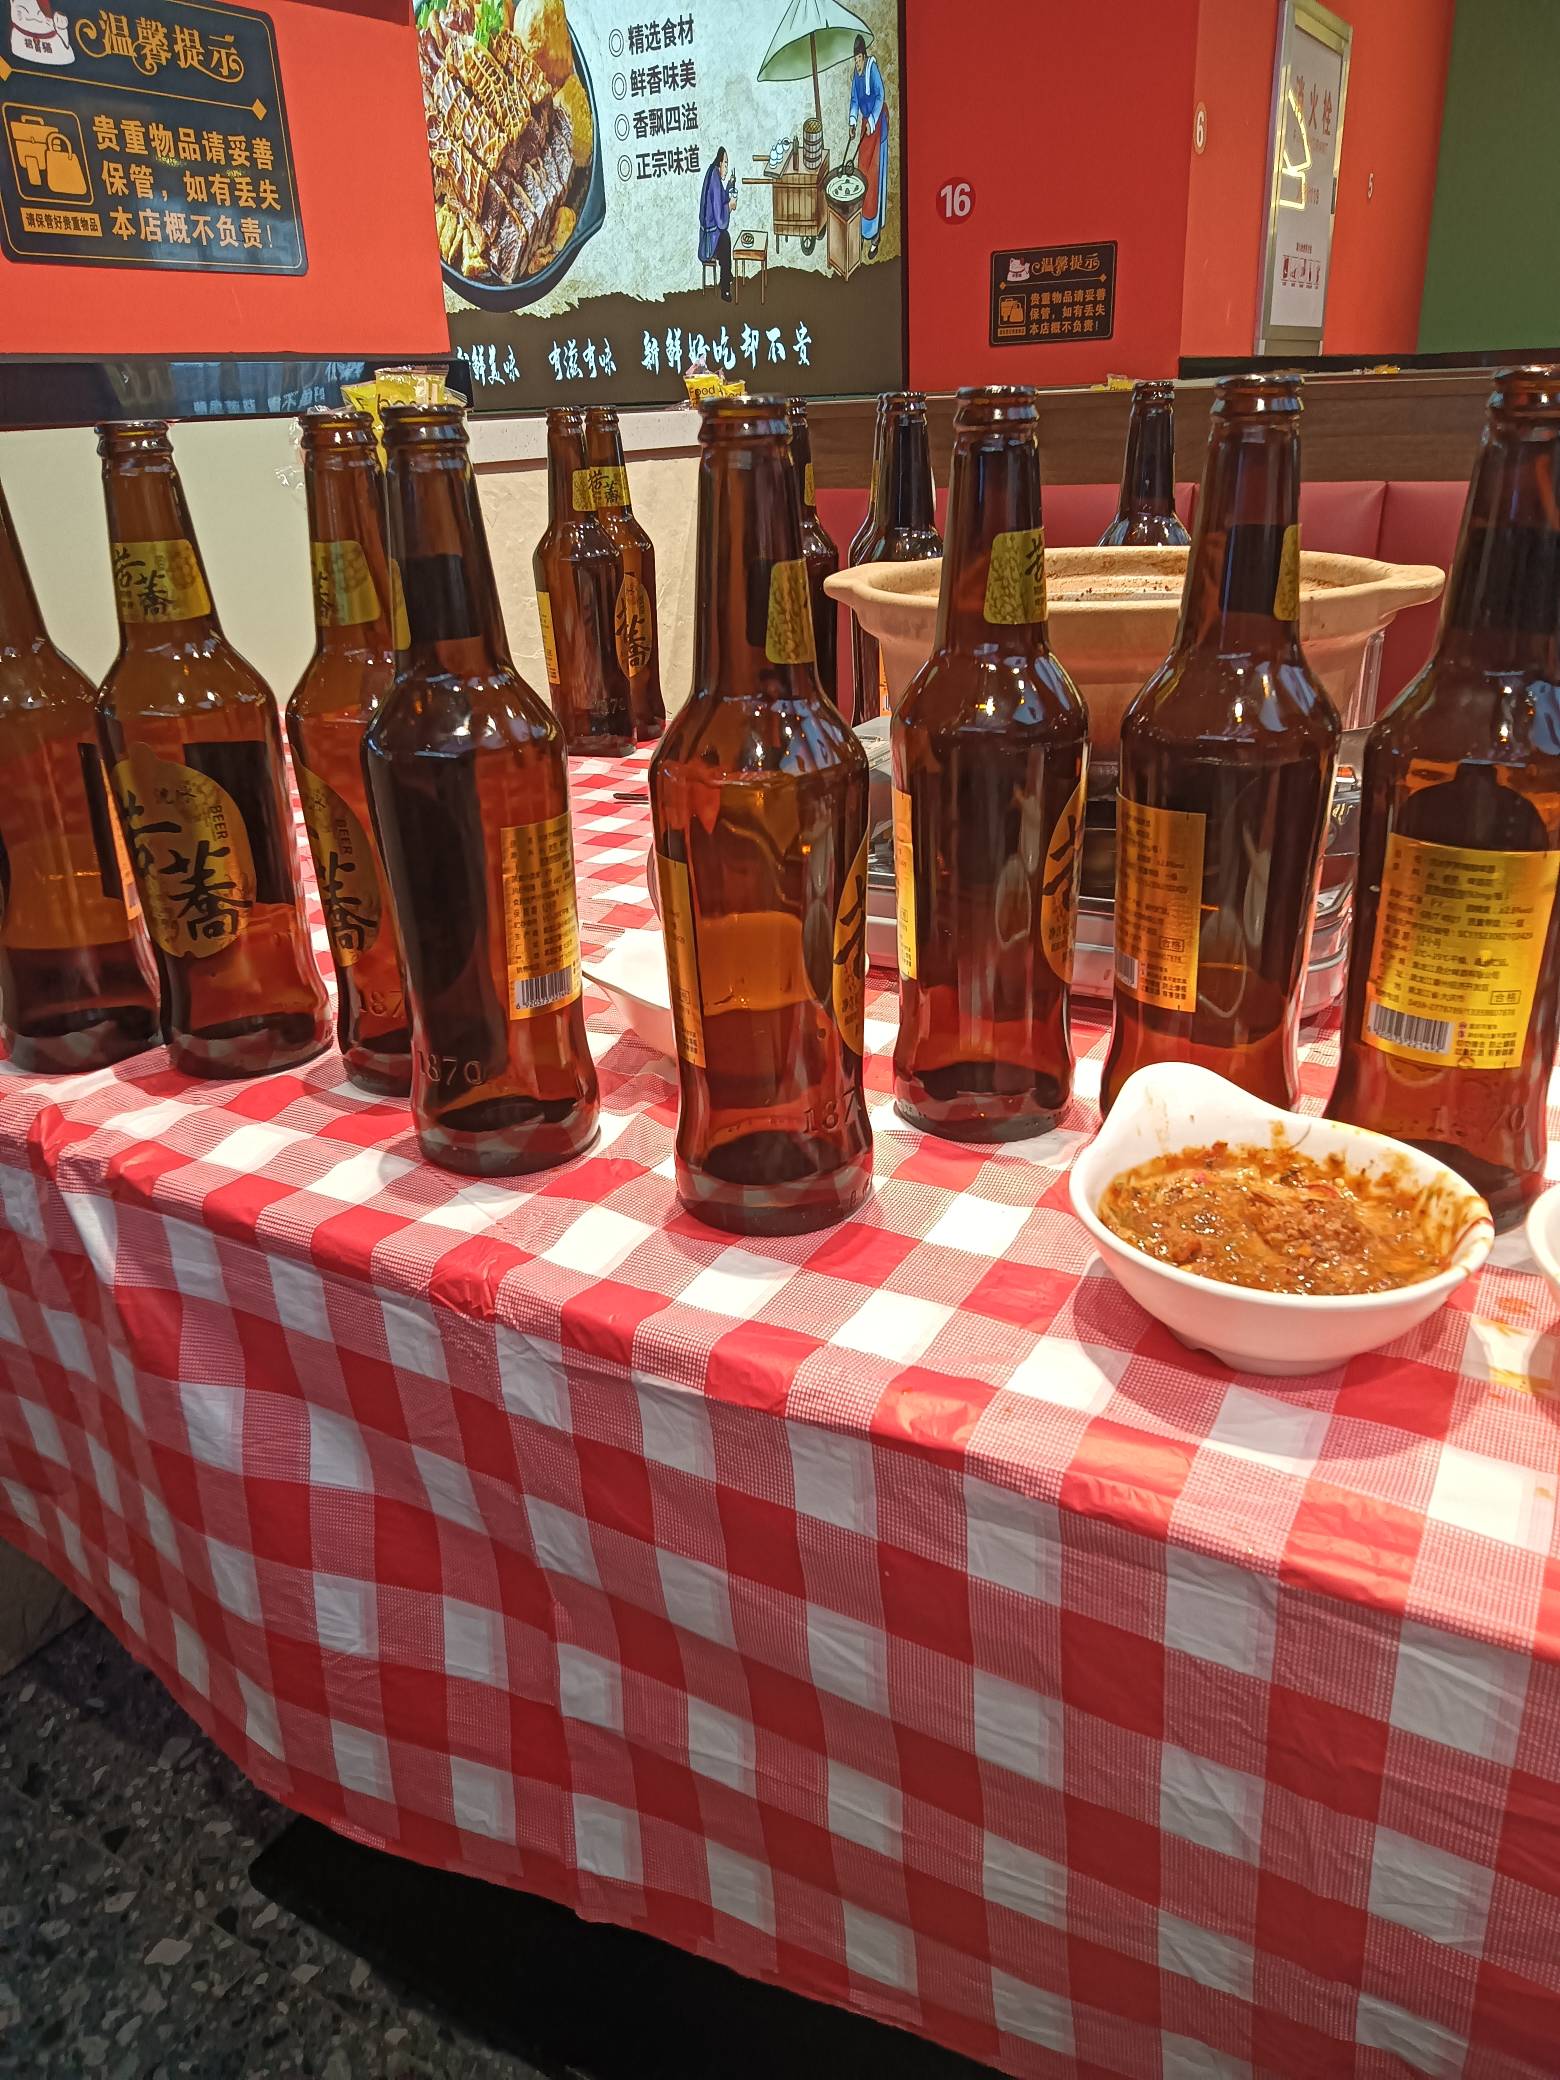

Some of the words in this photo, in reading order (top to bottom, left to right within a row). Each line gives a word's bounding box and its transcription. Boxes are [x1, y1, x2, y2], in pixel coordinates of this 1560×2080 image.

[76, 10, 244, 81] 温馨提示
[627, 13, 695, 56] 精选食材
[630, 58, 697, 98] 鲜香味美
[632, 101, 699, 140] 香飘四溢
[1196, 111, 1205, 148] 6
[92, 114, 274, 172] 贵重物品请妥善
[635, 144, 701, 180] 正宗味道
[101, 160, 282, 211] 保管，如有丢失
[940, 182, 972, 218] 16
[25, 212, 99, 233] 请保管好贵重物品
[1032, 252, 1101, 277] 温馨提示
[1029, 288, 1107, 305] 贵重物品请妥善
[689, 384, 716, 397] Food
[209, 805, 229, 840] BEER
